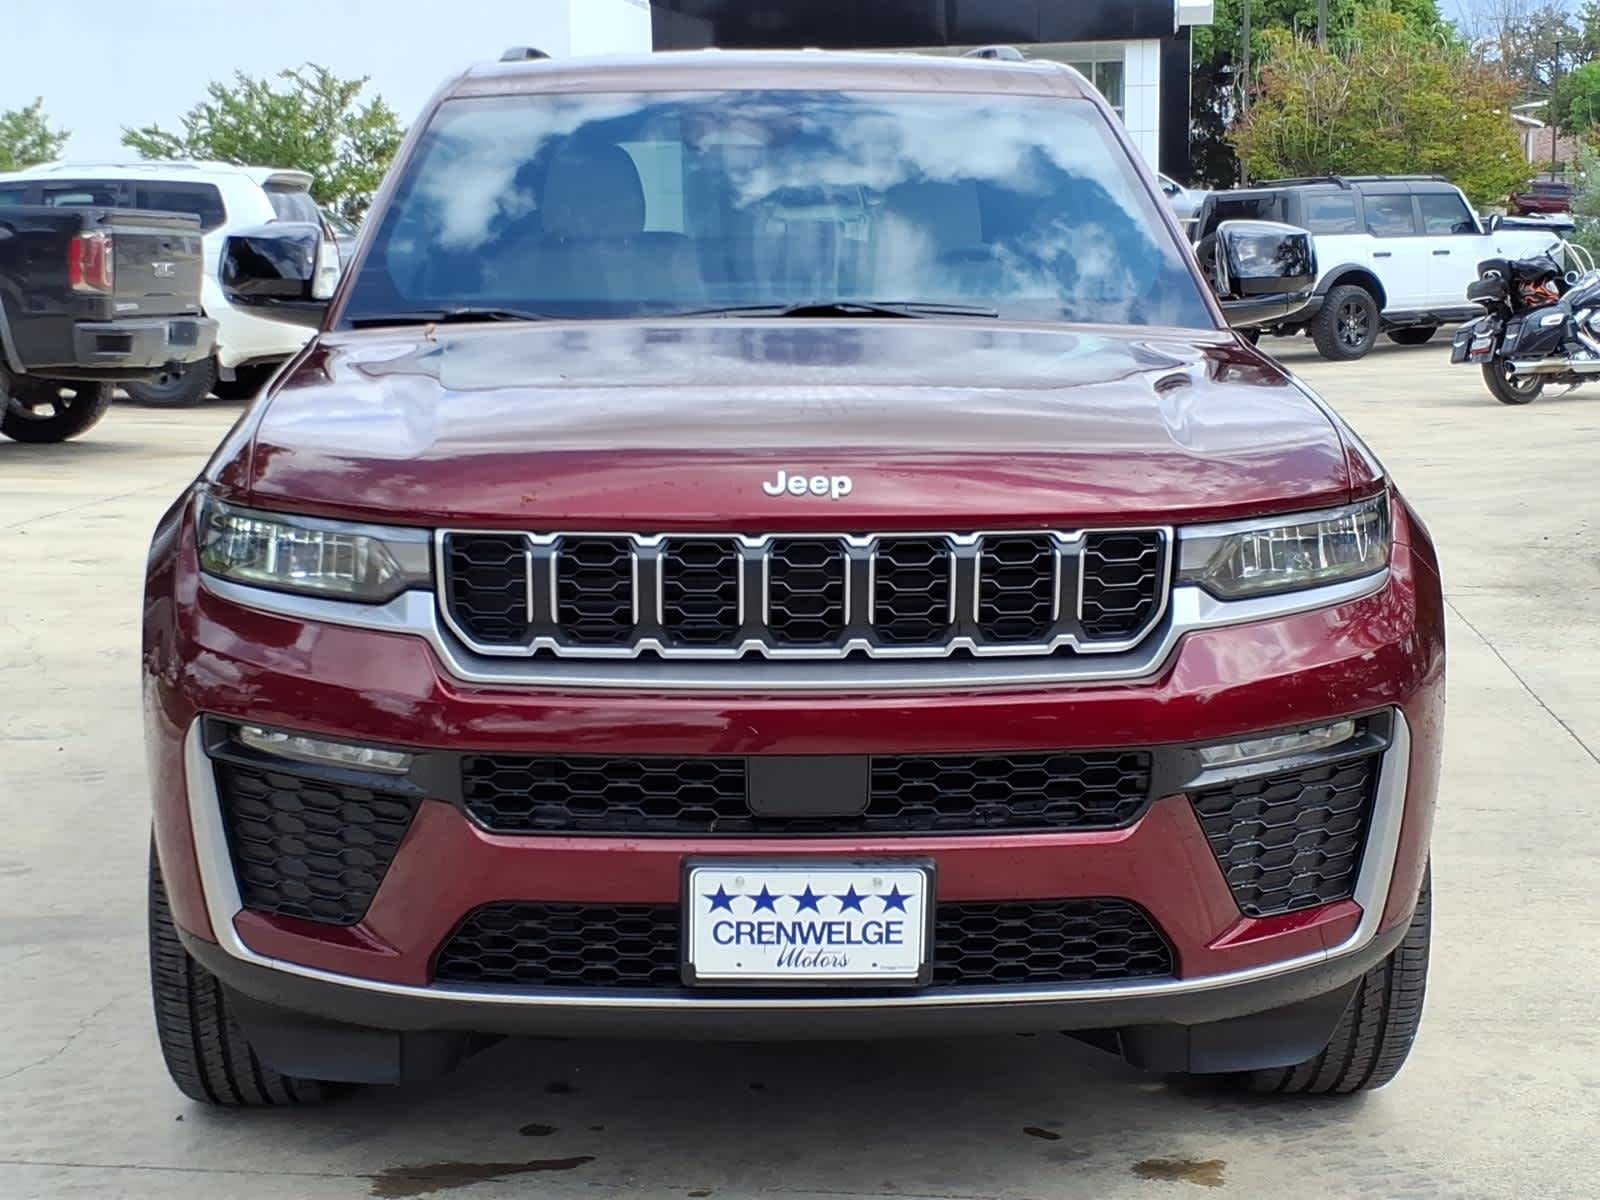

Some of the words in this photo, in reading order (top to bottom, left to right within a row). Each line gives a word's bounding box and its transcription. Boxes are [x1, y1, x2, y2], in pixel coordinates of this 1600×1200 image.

[762, 470, 853, 500] Jeep
[712, 920, 904, 945] CRENWELGE
[776, 942, 849, 968] Motors
